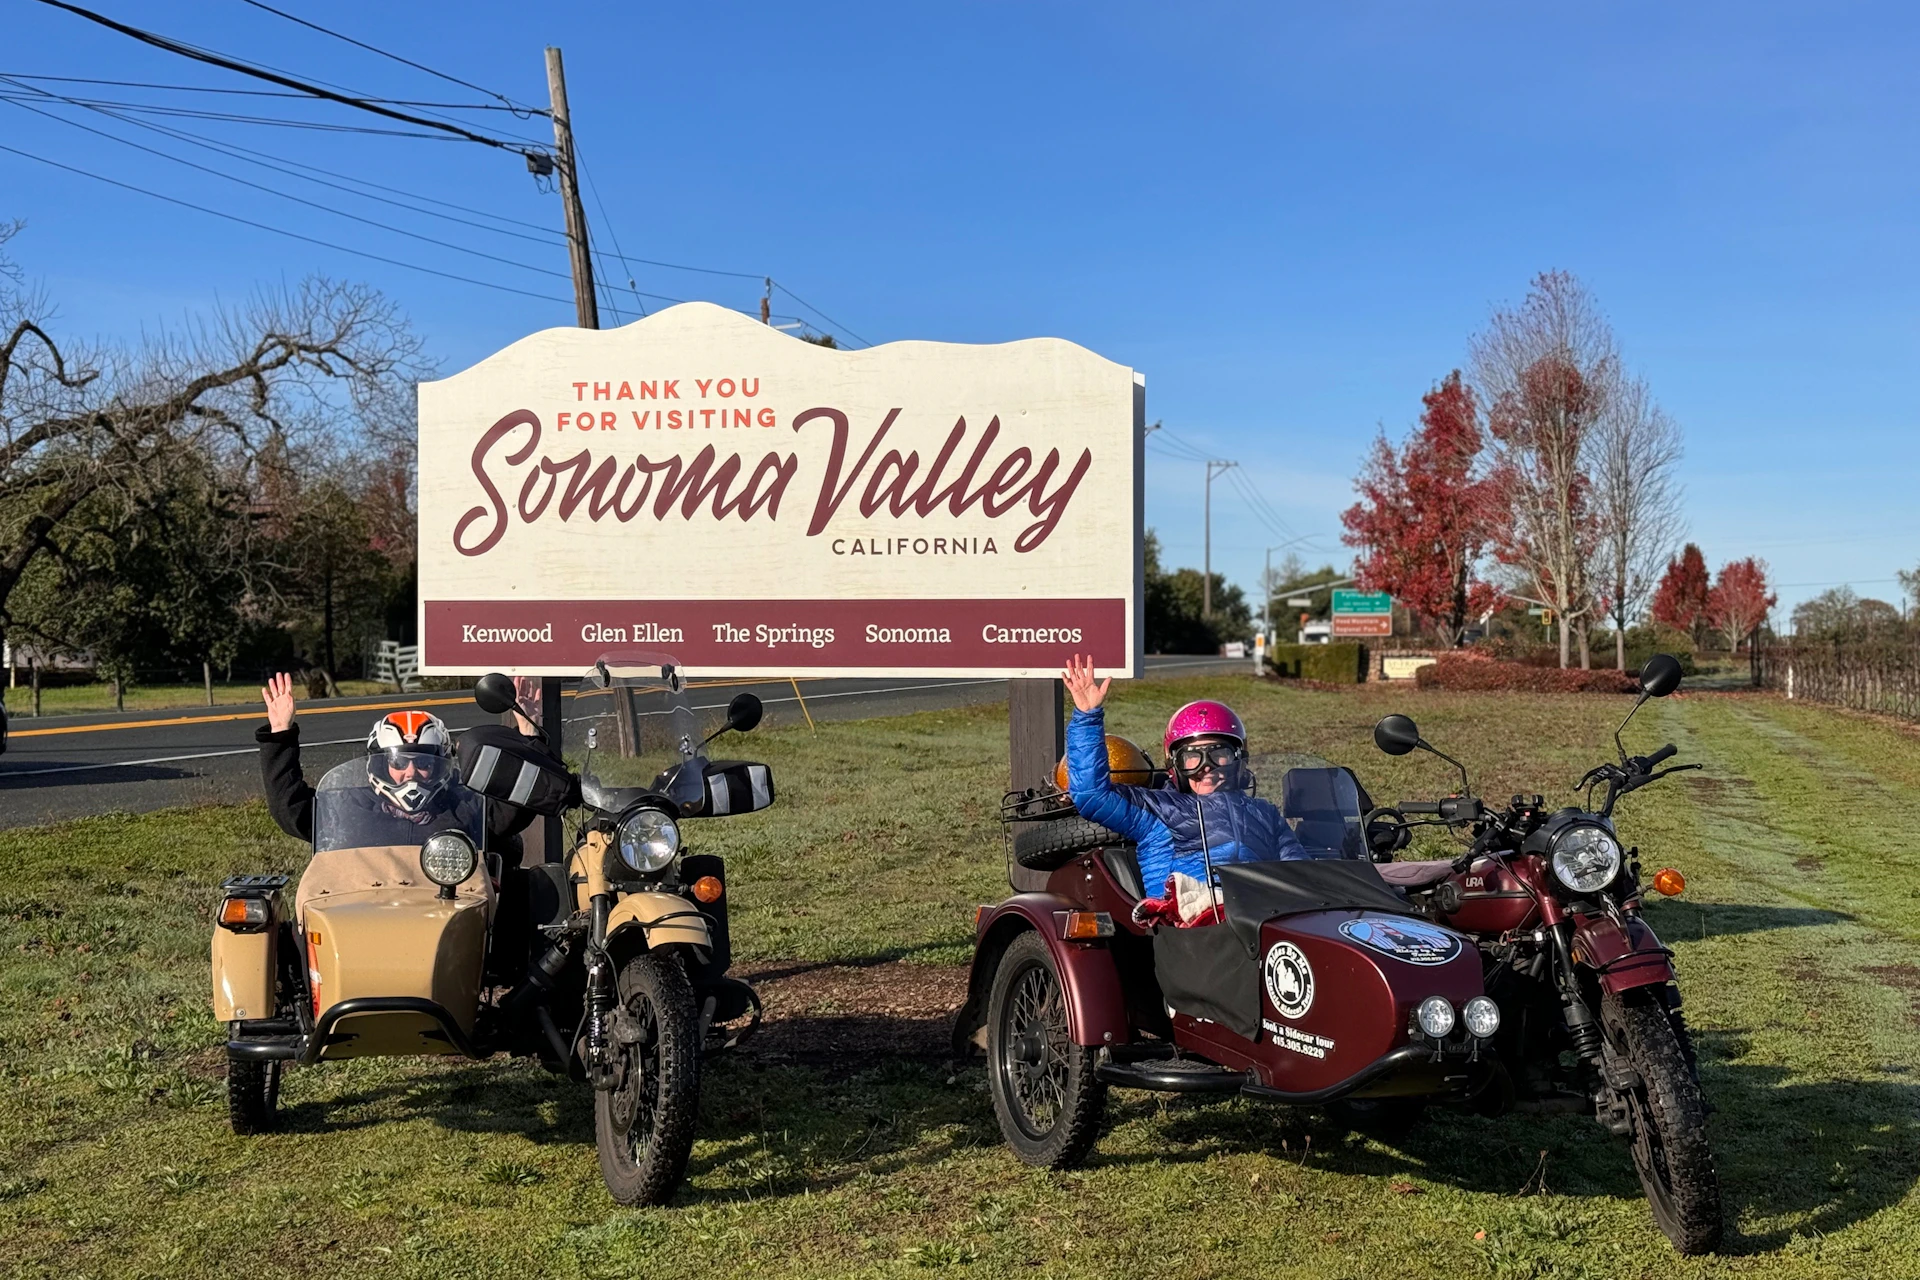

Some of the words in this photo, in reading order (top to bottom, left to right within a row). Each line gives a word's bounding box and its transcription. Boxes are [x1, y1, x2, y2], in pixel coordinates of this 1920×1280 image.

[572, 380, 681, 401] THANK
[696, 378, 760, 398] YOU
[557, 411, 619, 432] FOR
[635, 408, 777, 430] VISITING
[453, 408, 798, 557] Sonoma
[792, 407, 1092, 554] Valley
[831, 537, 998, 556] CALIFORNIA
[461, 622, 554, 643] Kenwood
[581, 622, 628, 643] Glen
[632, 622, 685, 643] Ellen
[712, 622, 751, 643] The
[755, 622, 835, 649] Springs
[865, 623, 952, 644] Sonoma
[982, 623, 1083, 644] Carneros
[1268, 947, 1286, 968] Rides
[1286, 946, 1297, 960] By
[1267, 975, 1281, 1007] Classic
[1280, 1003, 1303, 1015] Sidecar
[1301, 983, 1312, 1008] Tours
[1272, 1034, 1325, 1059] 415.305.8229
[1279, 1026, 1285, 1035] a
[1285, 1026, 1315, 1044] Sidecar
[1315, 1035, 1335, 1050] tour
